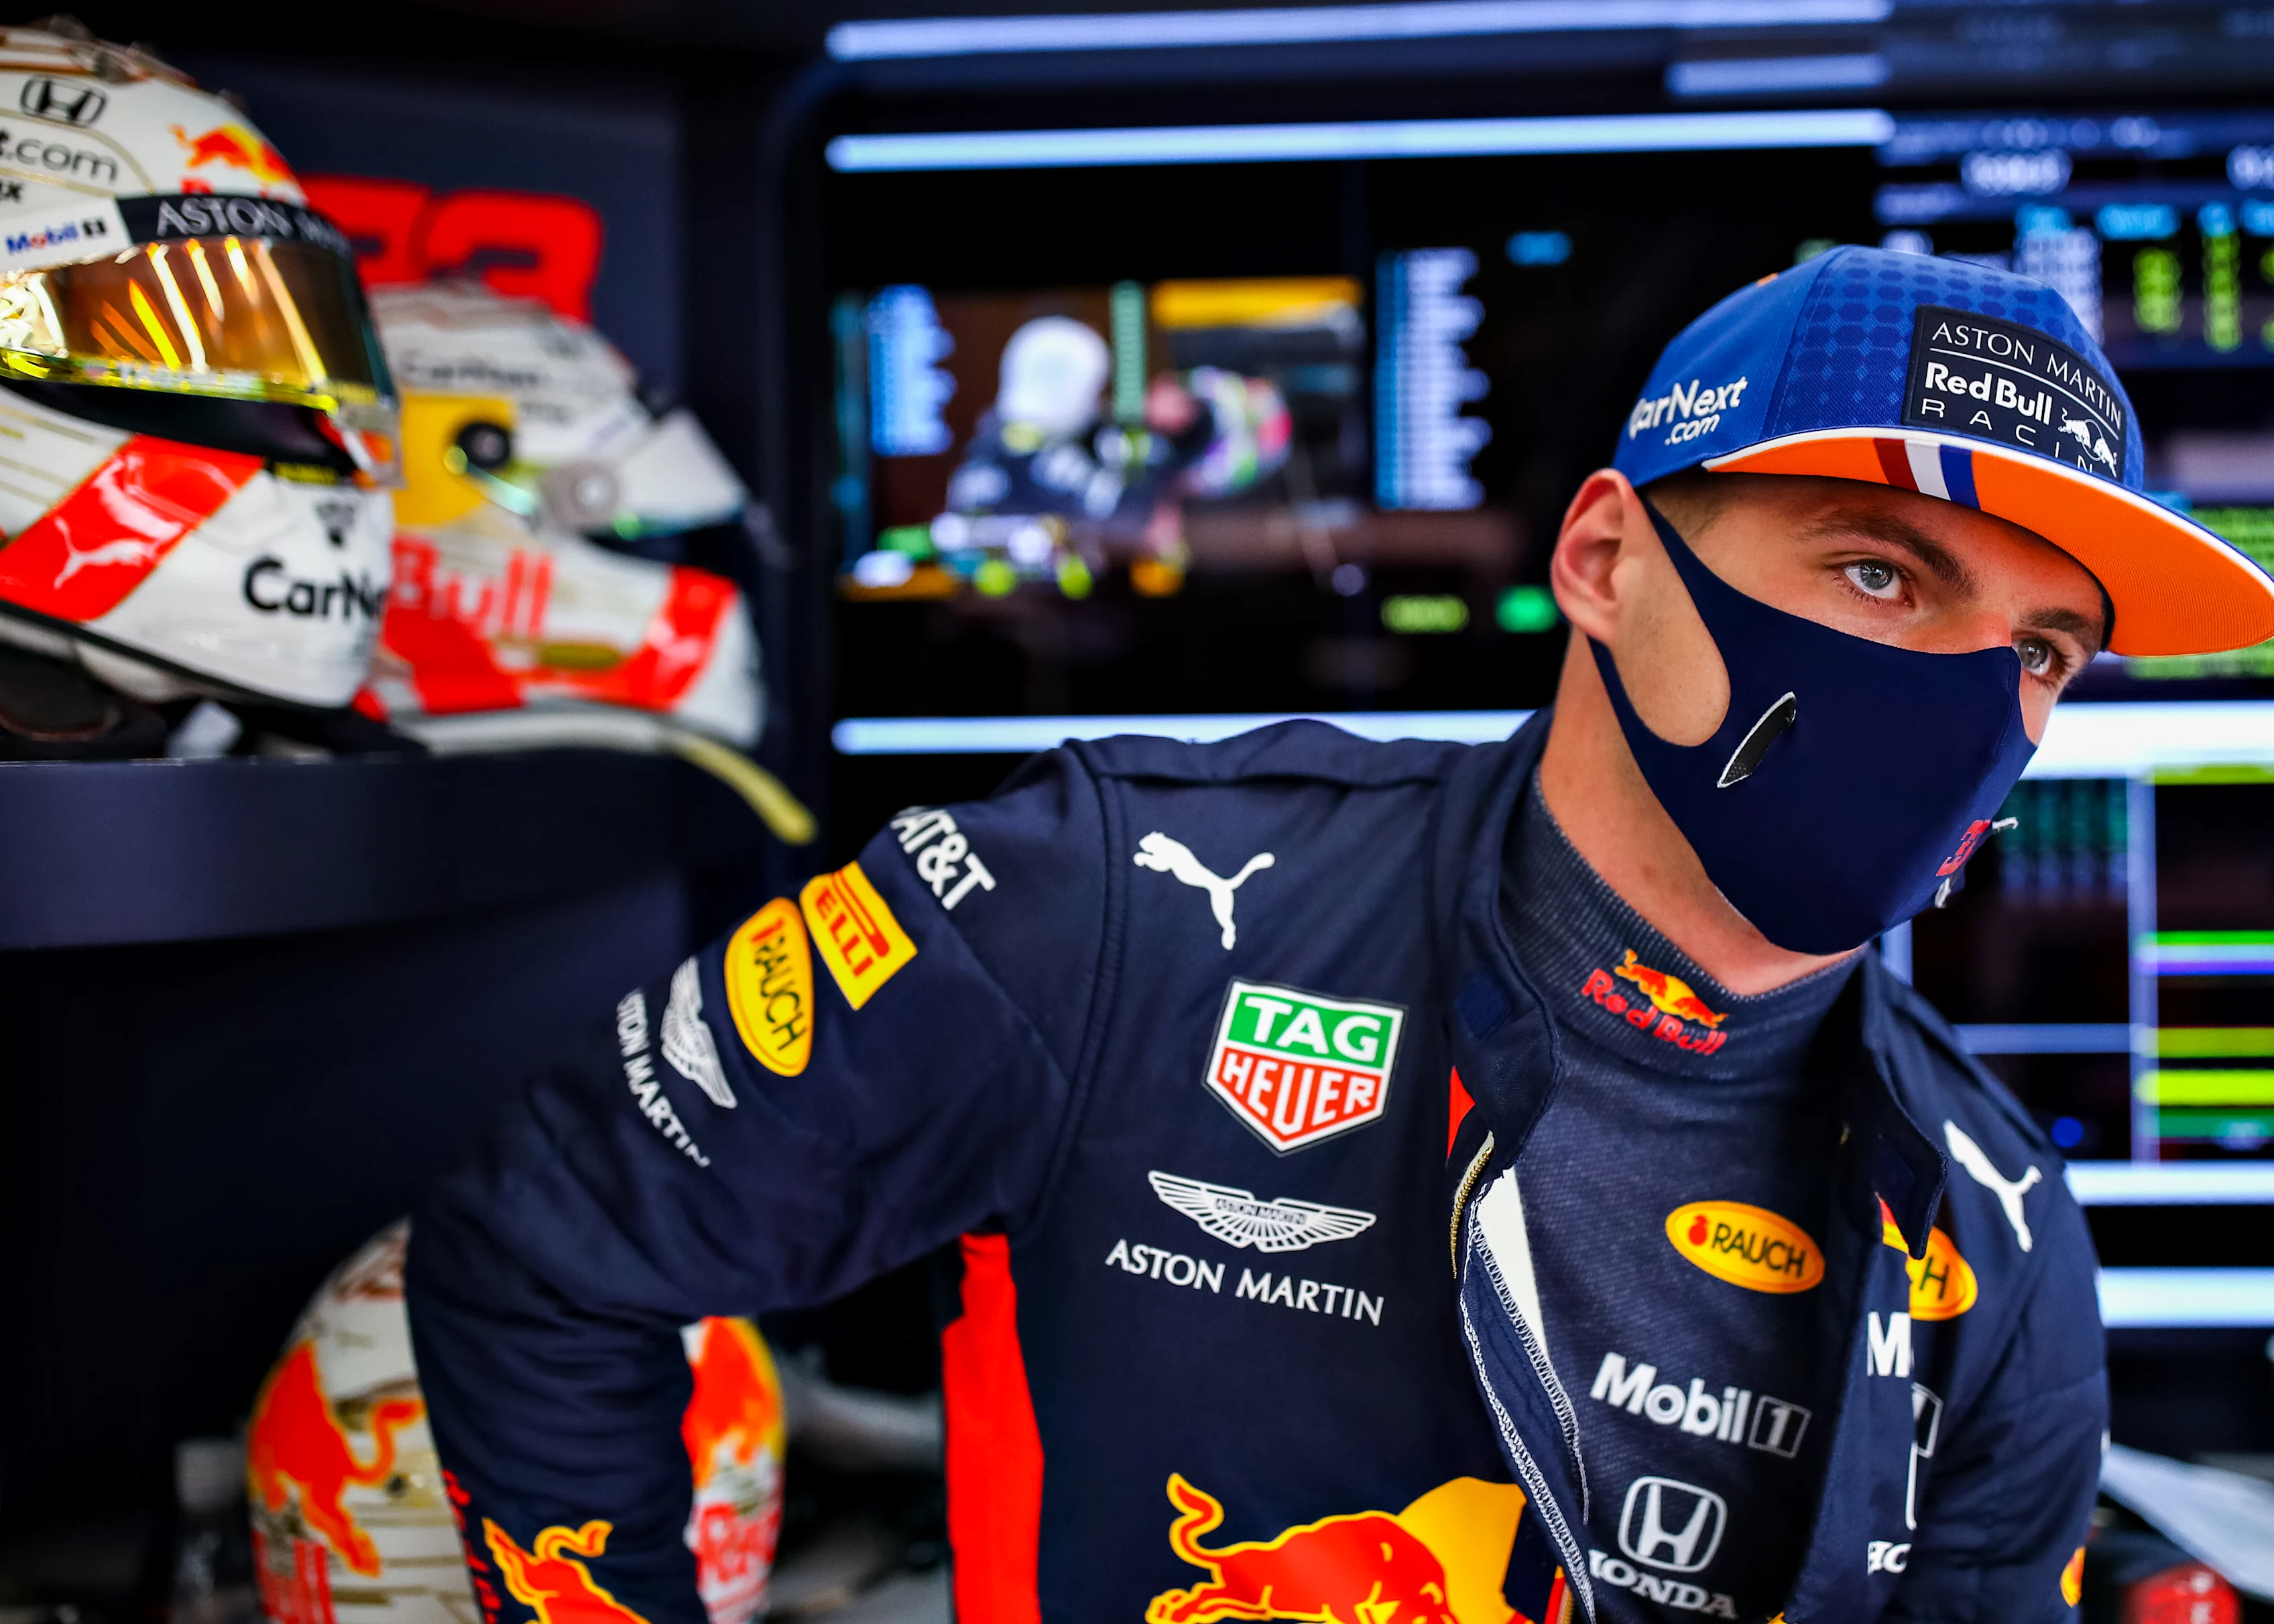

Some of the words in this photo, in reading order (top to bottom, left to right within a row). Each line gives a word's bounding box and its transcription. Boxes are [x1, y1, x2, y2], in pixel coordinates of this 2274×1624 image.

[156, 198, 294, 237] ASTON
[1925, 361, 1992, 402] Red
[1995, 377, 2052, 426] Bull
[1931, 322, 2034, 365] ASTON
[2047, 353, 2122, 430] MARTIN
[1664, 414, 1721, 446] .com
[1921, 398, 2094, 473] RACIN
[890, 808, 997, 911] AT&T
[752, 936, 809, 1051] RAUCH
[1244, 996, 1382, 1062] TAG
[1581, 968, 1659, 1030] Red
[1653, 1015, 1728, 1056] Bull
[623, 1053, 711, 1168] MARTIN
[1221, 1052, 1376, 1136] HEUER
[1105, 1239, 1226, 1294] ASTON
[1235, 1267, 1385, 1327] MARTIN
[1710, 1223, 1807, 1279] RAUCH
[1590, 1351, 1753, 1444] Mobil
